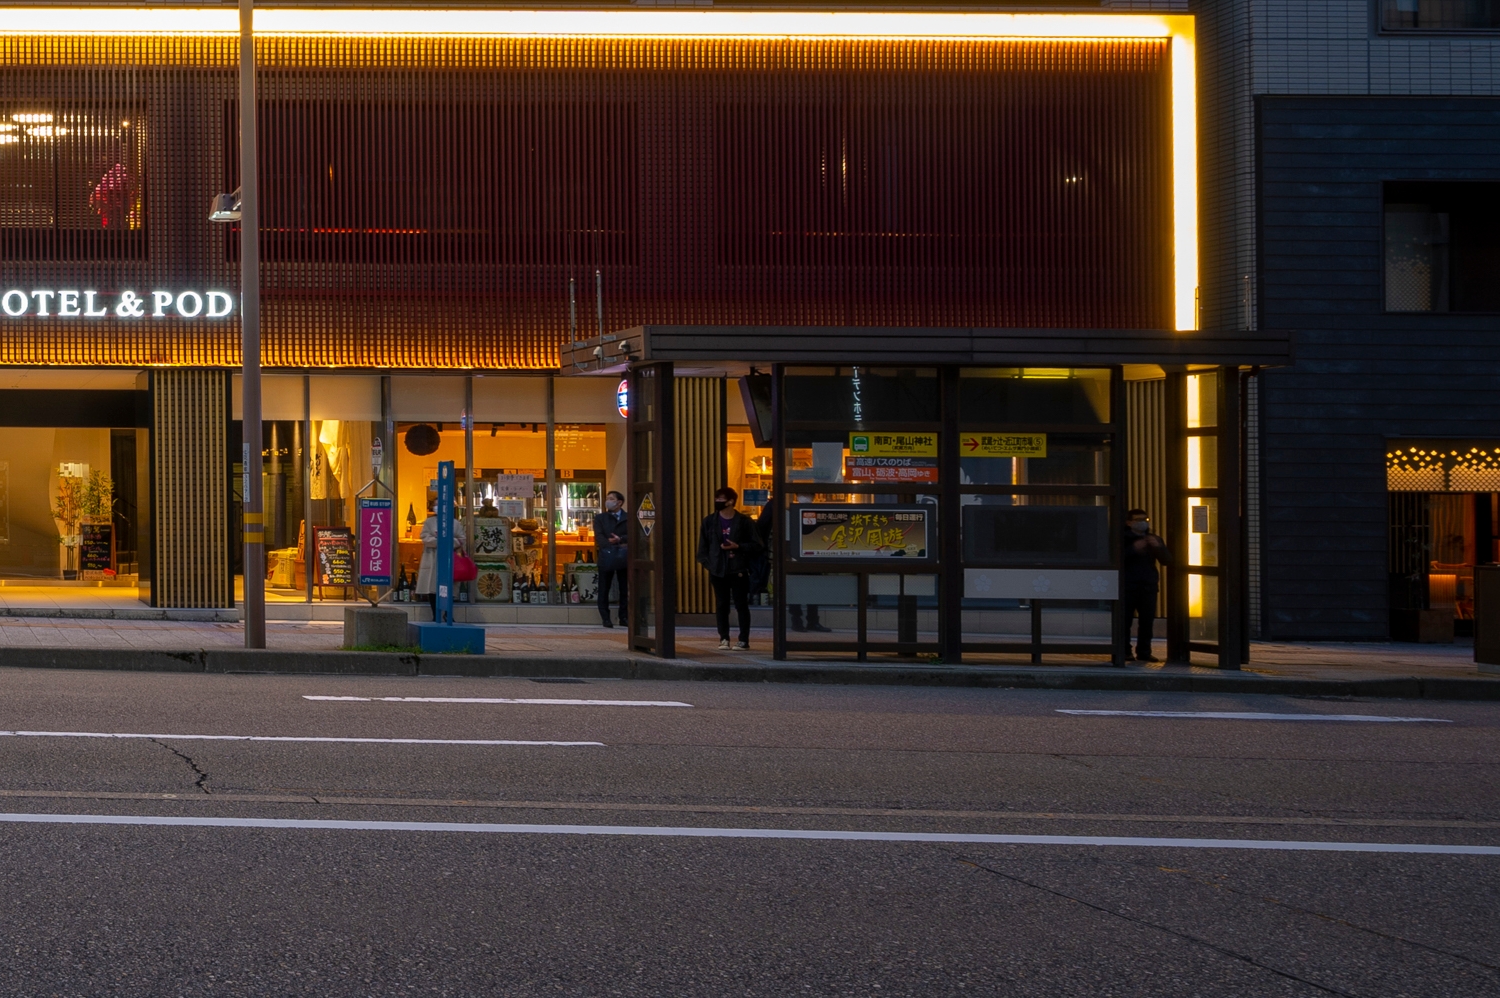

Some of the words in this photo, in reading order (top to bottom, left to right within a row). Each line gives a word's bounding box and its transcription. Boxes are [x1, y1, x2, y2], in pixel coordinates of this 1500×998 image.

[115, 290, 144, 317] &
[151, 291, 233, 318] POD
[873, 436, 933, 446] 南町・尾山神社
[856, 458, 912, 466] 高速バスのりば
[895, 513, 924, 521] 毎日運行
[369, 512, 383, 572] バスのりば
[830, 525, 907, 549] 金沢周遊
